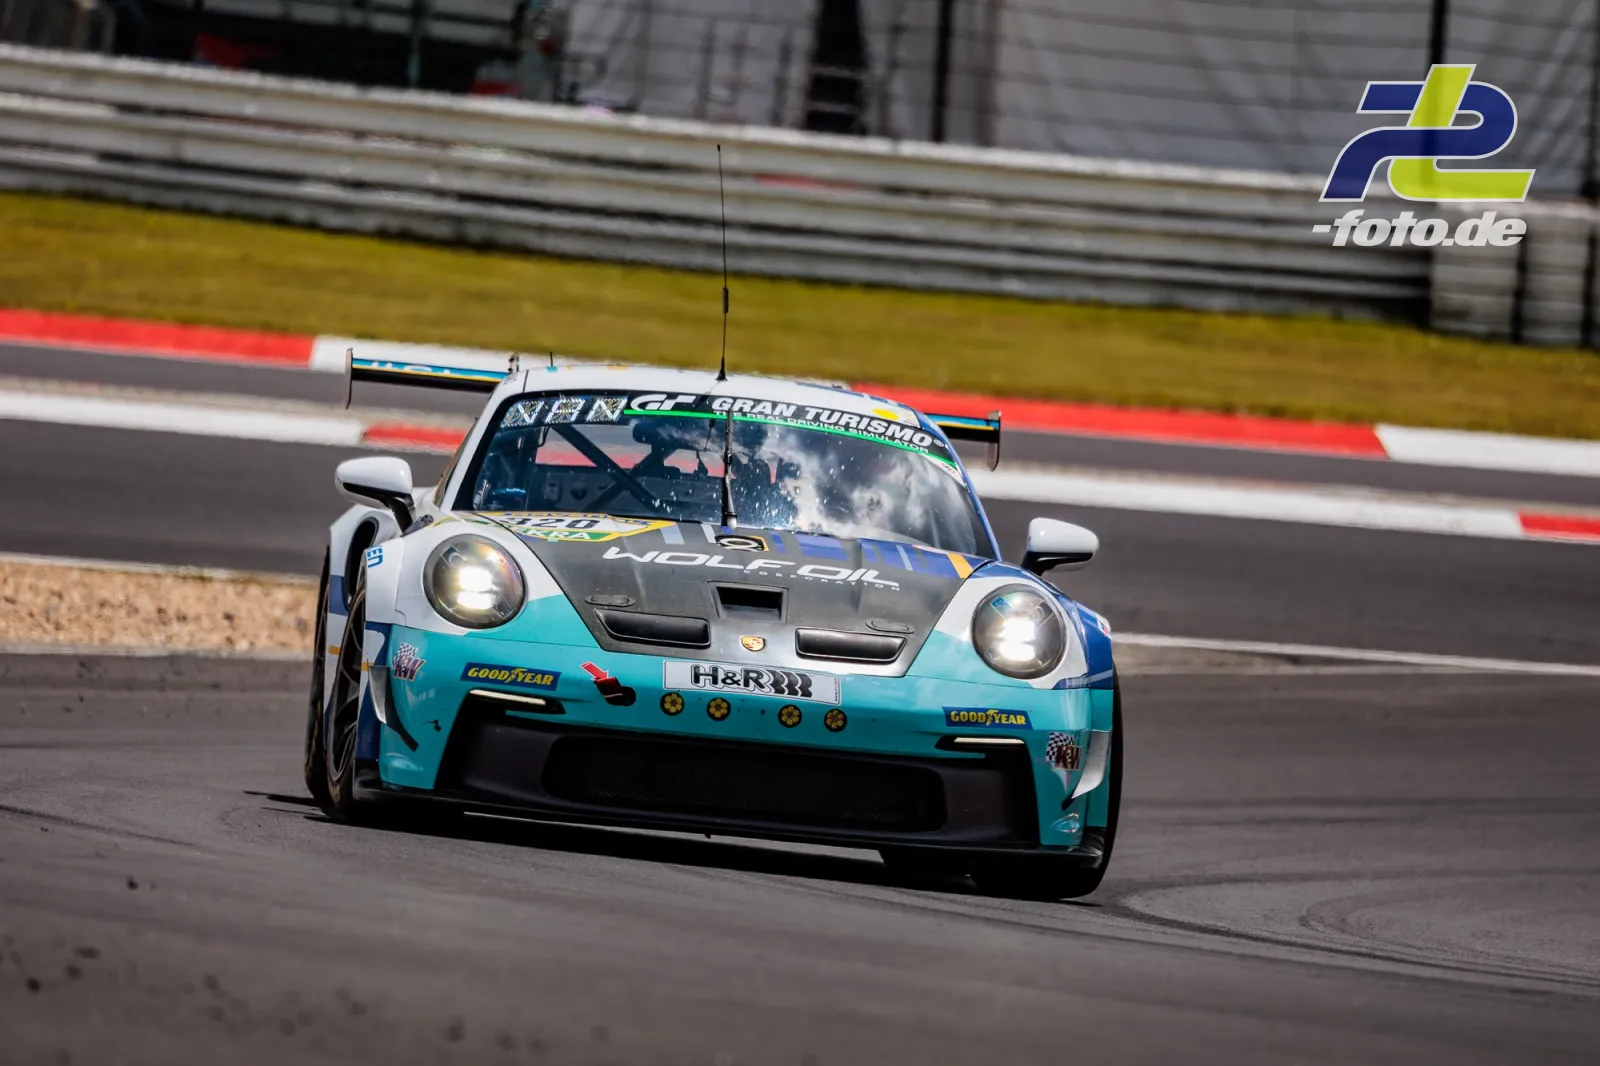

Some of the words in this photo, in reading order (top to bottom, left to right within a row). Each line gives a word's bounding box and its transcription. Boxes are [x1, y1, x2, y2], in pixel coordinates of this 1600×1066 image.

[711, 397, 797, 417] GRAN
[848, 428, 930, 453] SIMULATOR
[743, 568, 901, 592] CORPORATION
[467, 667, 554, 685] GOODYEAR
[691, 664, 774, 693] H&R
[950, 709, 1027, 726] GOODYEAR
